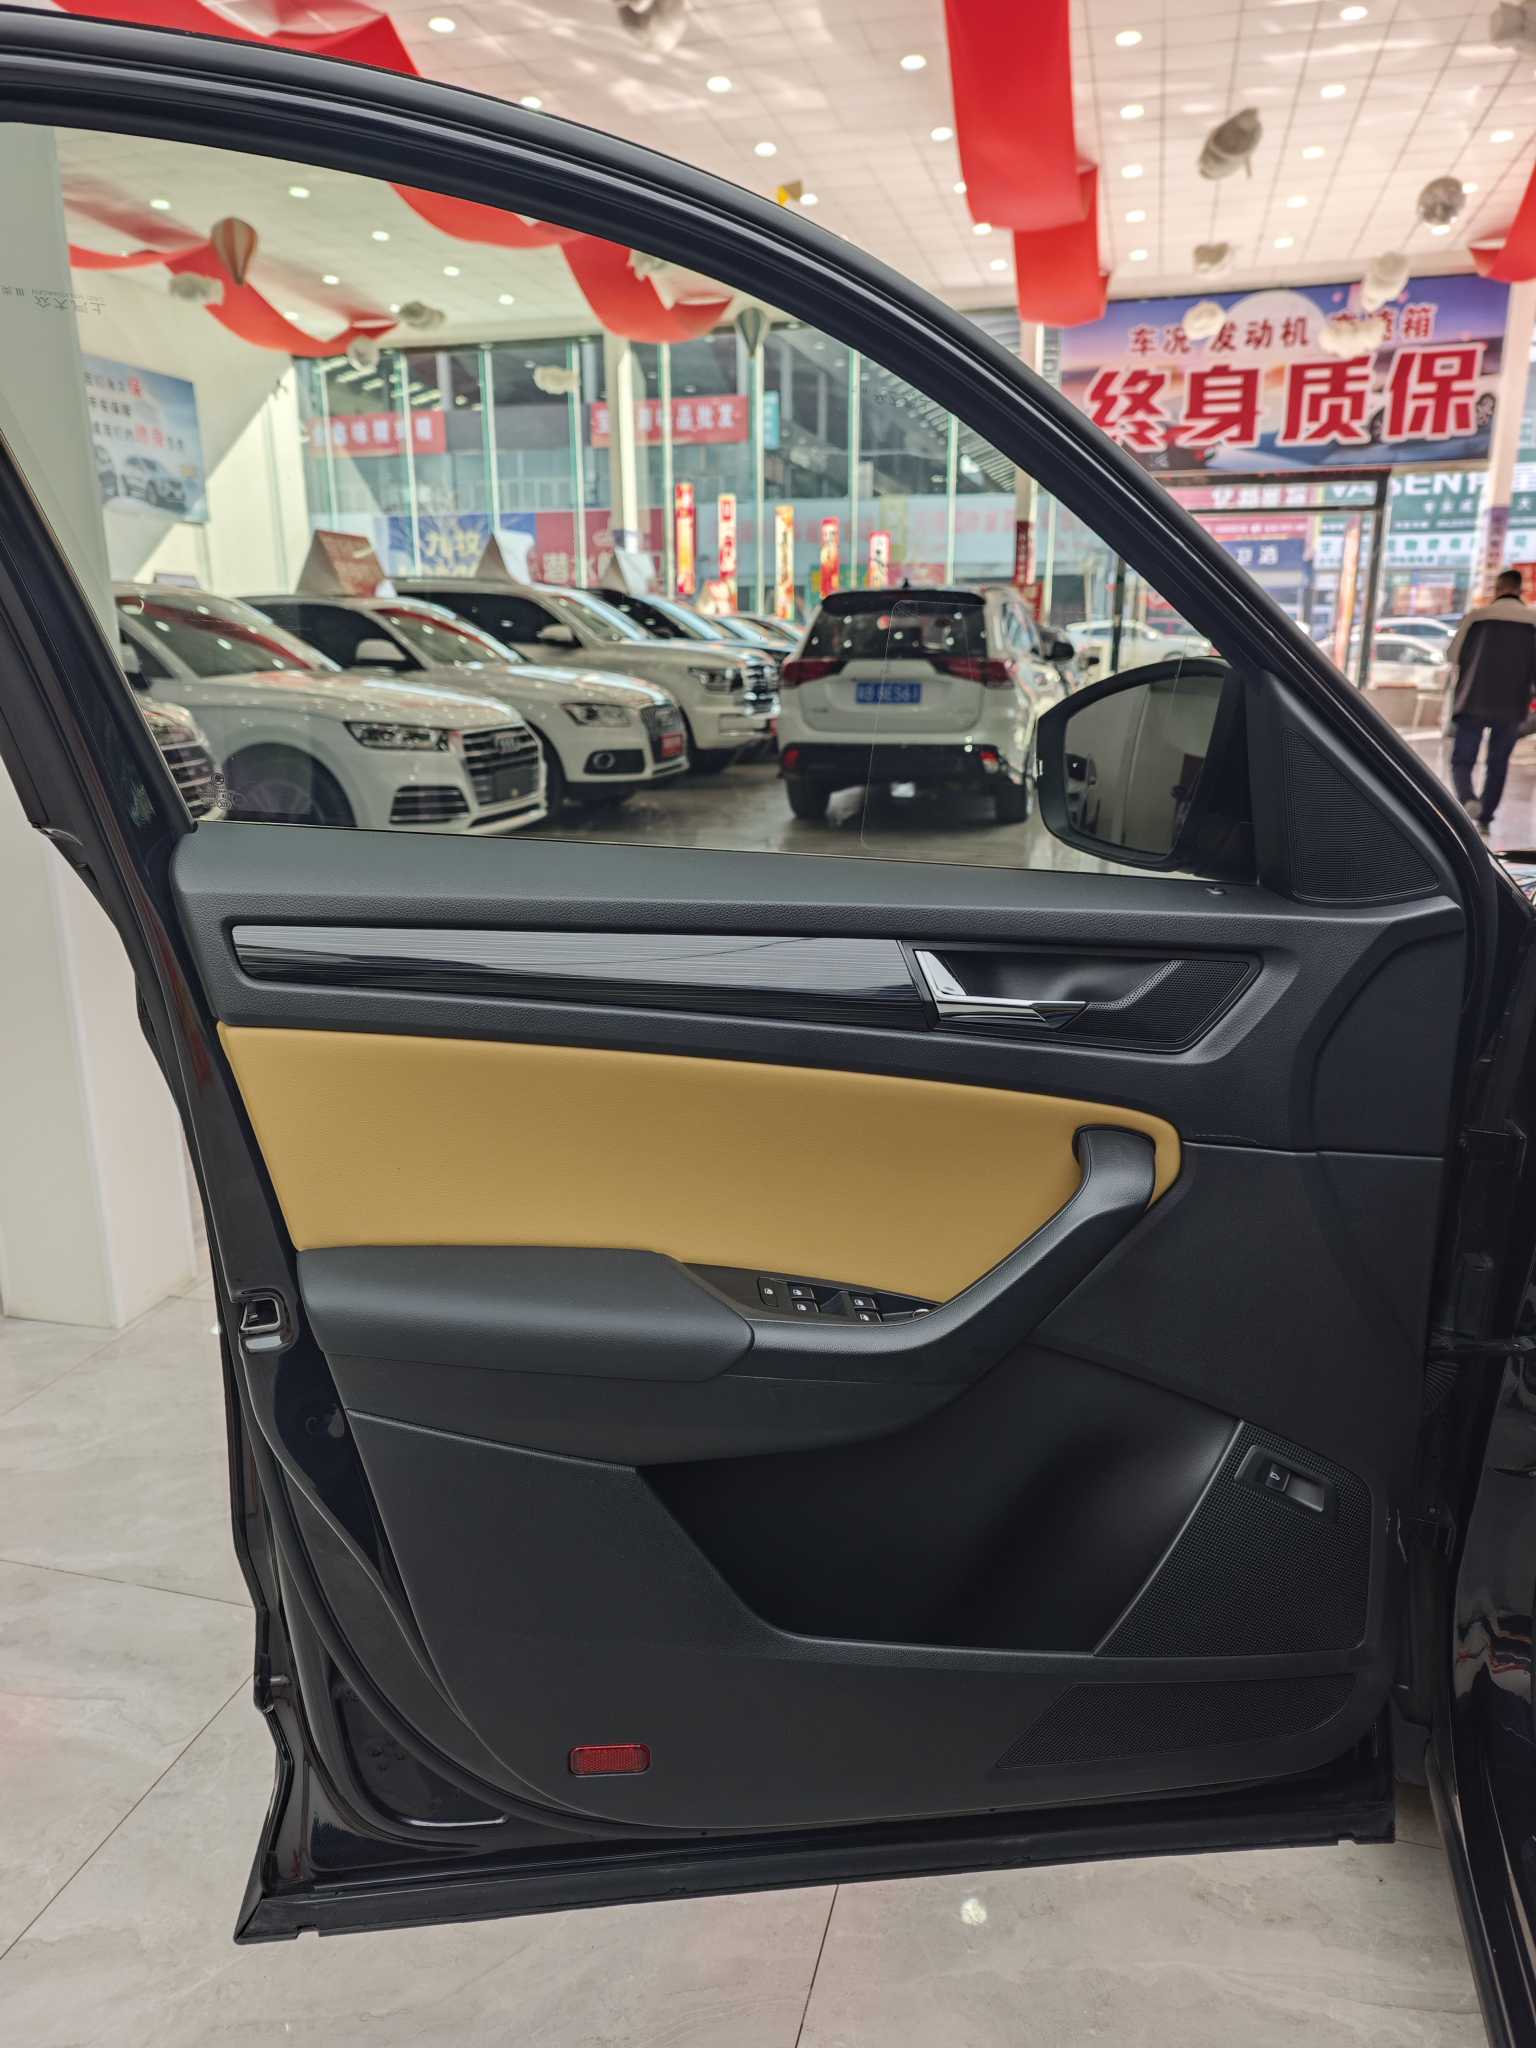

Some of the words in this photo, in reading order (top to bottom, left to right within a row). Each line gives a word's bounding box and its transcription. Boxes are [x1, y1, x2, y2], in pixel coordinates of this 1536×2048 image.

[1130, 324, 1192, 356] 车况
[1211, 315, 1310, 352] 发动机
[1087, 345, 1482, 450] 终身质保
